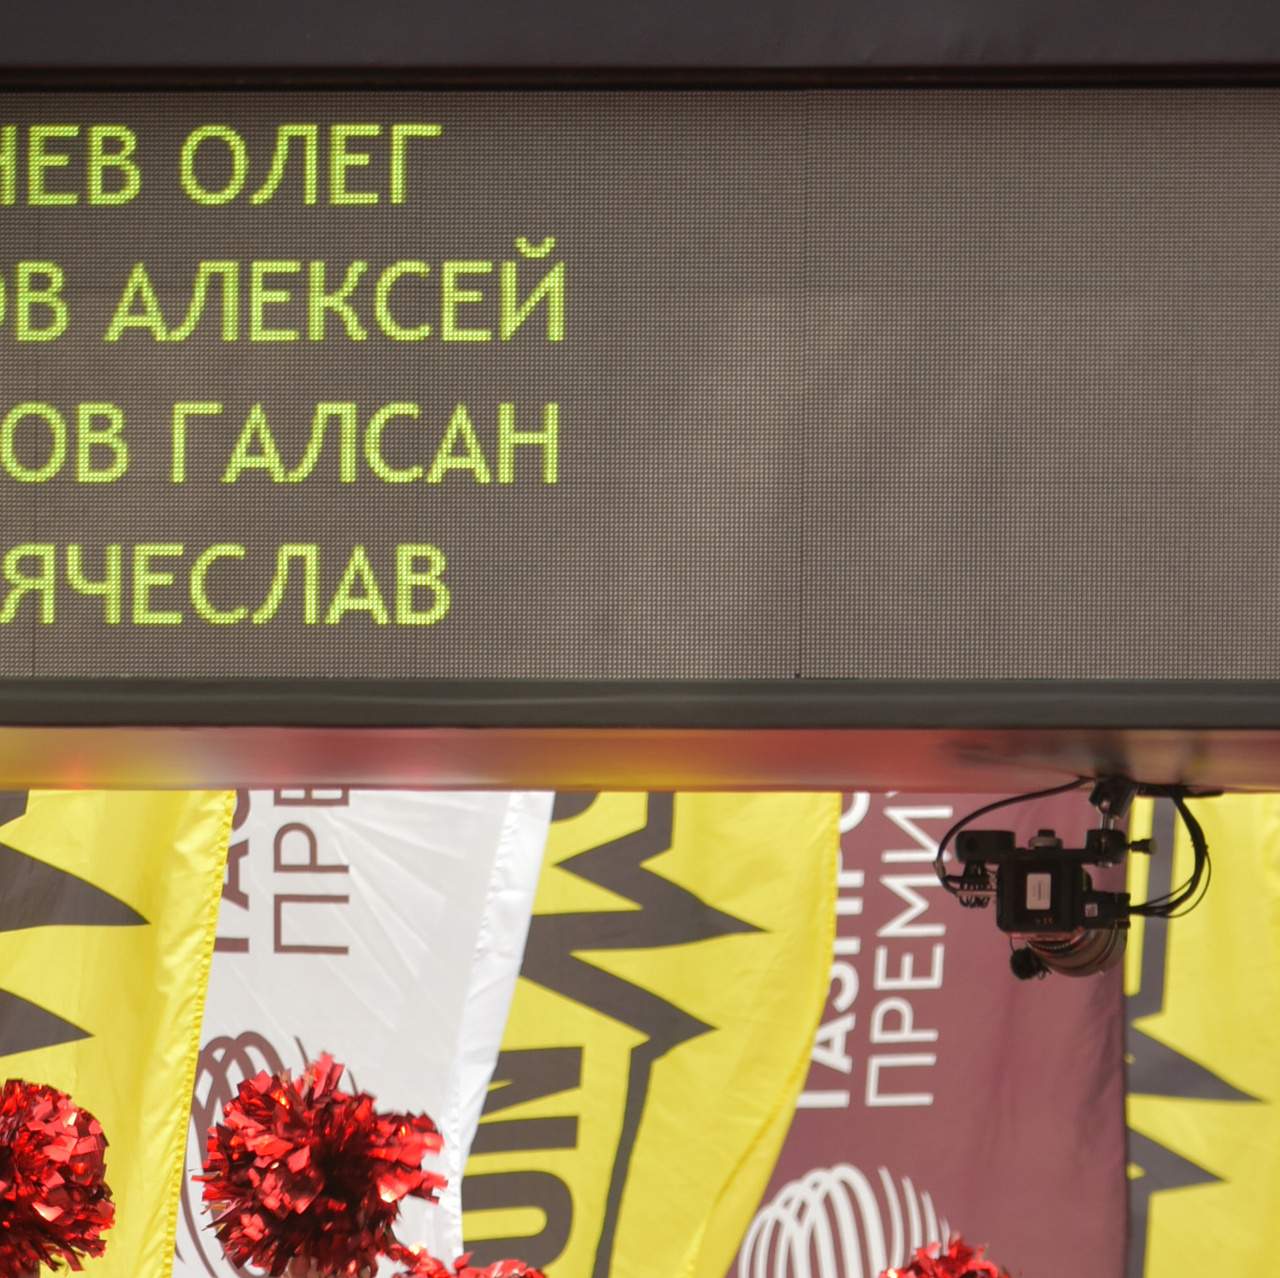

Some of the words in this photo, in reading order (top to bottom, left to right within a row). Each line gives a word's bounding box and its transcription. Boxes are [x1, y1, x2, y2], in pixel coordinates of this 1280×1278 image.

[181, 125, 443, 206] ОЛЕГ
[0, 262, 70, 343] В
[104, 237, 566, 344] АЛЕКСЕЙ
[0, 403, 130, 484] ОВ
[171, 403, 560, 485] ГАЛСАН
[0, 545, 452, 626] ЯЧЕСЛАВ
[864, 791, 955, 1108] ПРЕМИ
